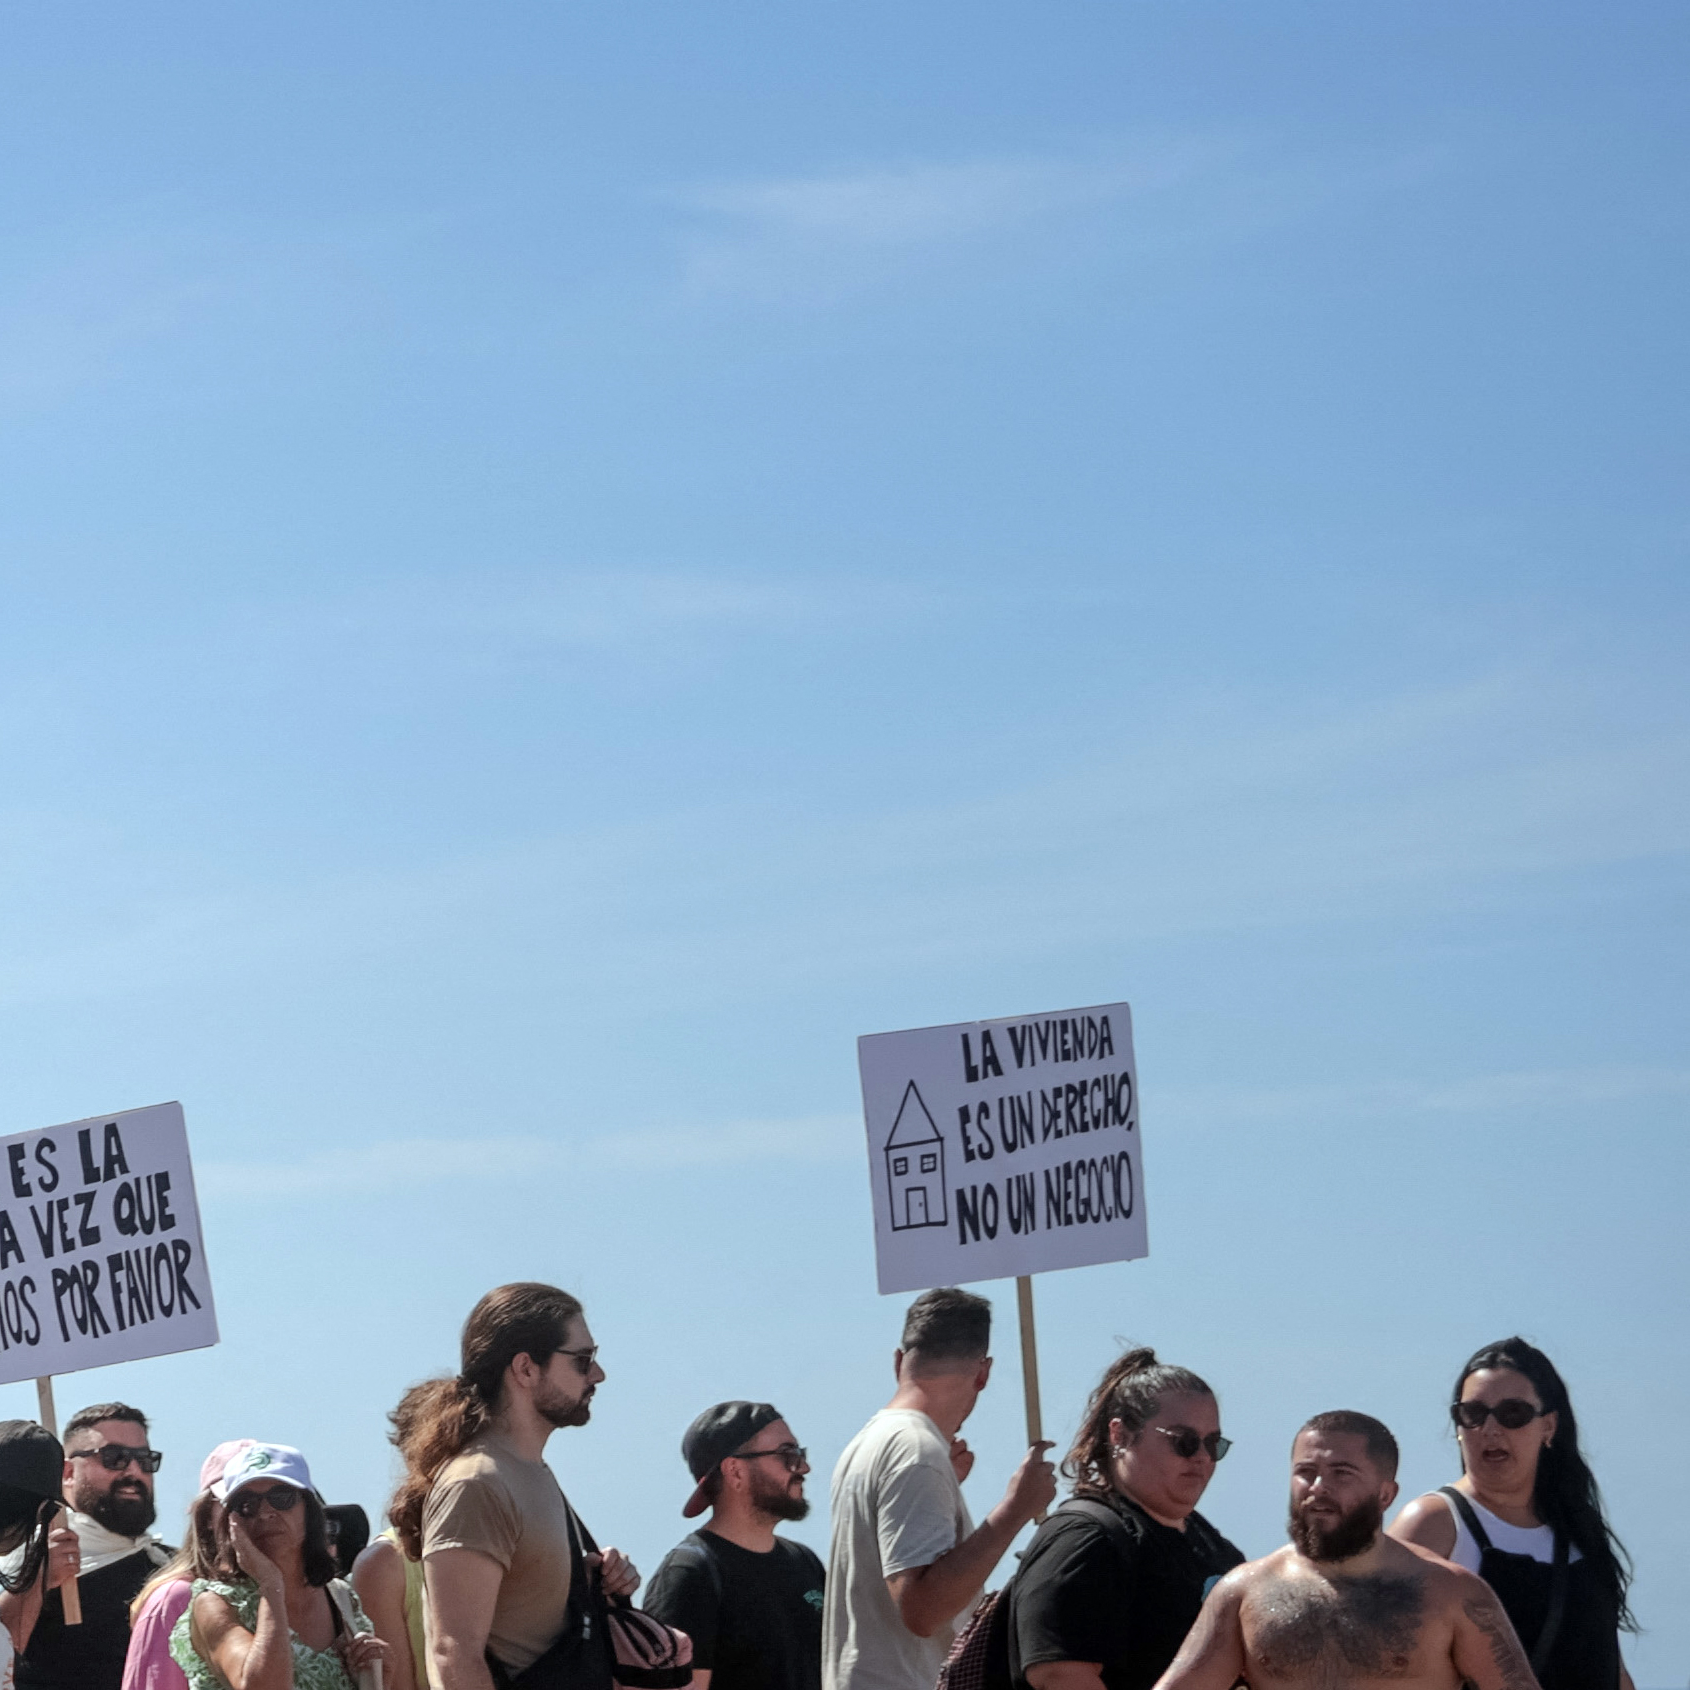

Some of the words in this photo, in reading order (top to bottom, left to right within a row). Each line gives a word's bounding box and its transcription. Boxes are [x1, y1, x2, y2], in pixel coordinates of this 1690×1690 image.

[961, 1029, 1004, 1083] LA
[1007, 1015, 1115, 1069] VIVIENDA
[7, 1137, 60, 1198] ES
[78, 1122, 131, 1185] LA
[958, 1101, 995, 1163] ES
[998, 1091, 1035, 1153] UN
[1040, 1071, 1134, 1143] DERECHO,
[29, 1189, 101, 1259] VEZ
[113, 1170, 176, 1236] QUE
[955, 1182, 999, 1245] NO
[1006, 1172, 1036, 1235] UN
[1044, 1151, 1133, 1230] NEGOCIO
[52, 1259, 112, 1343] POR
[106, 1238, 202, 1332] FAVOR
